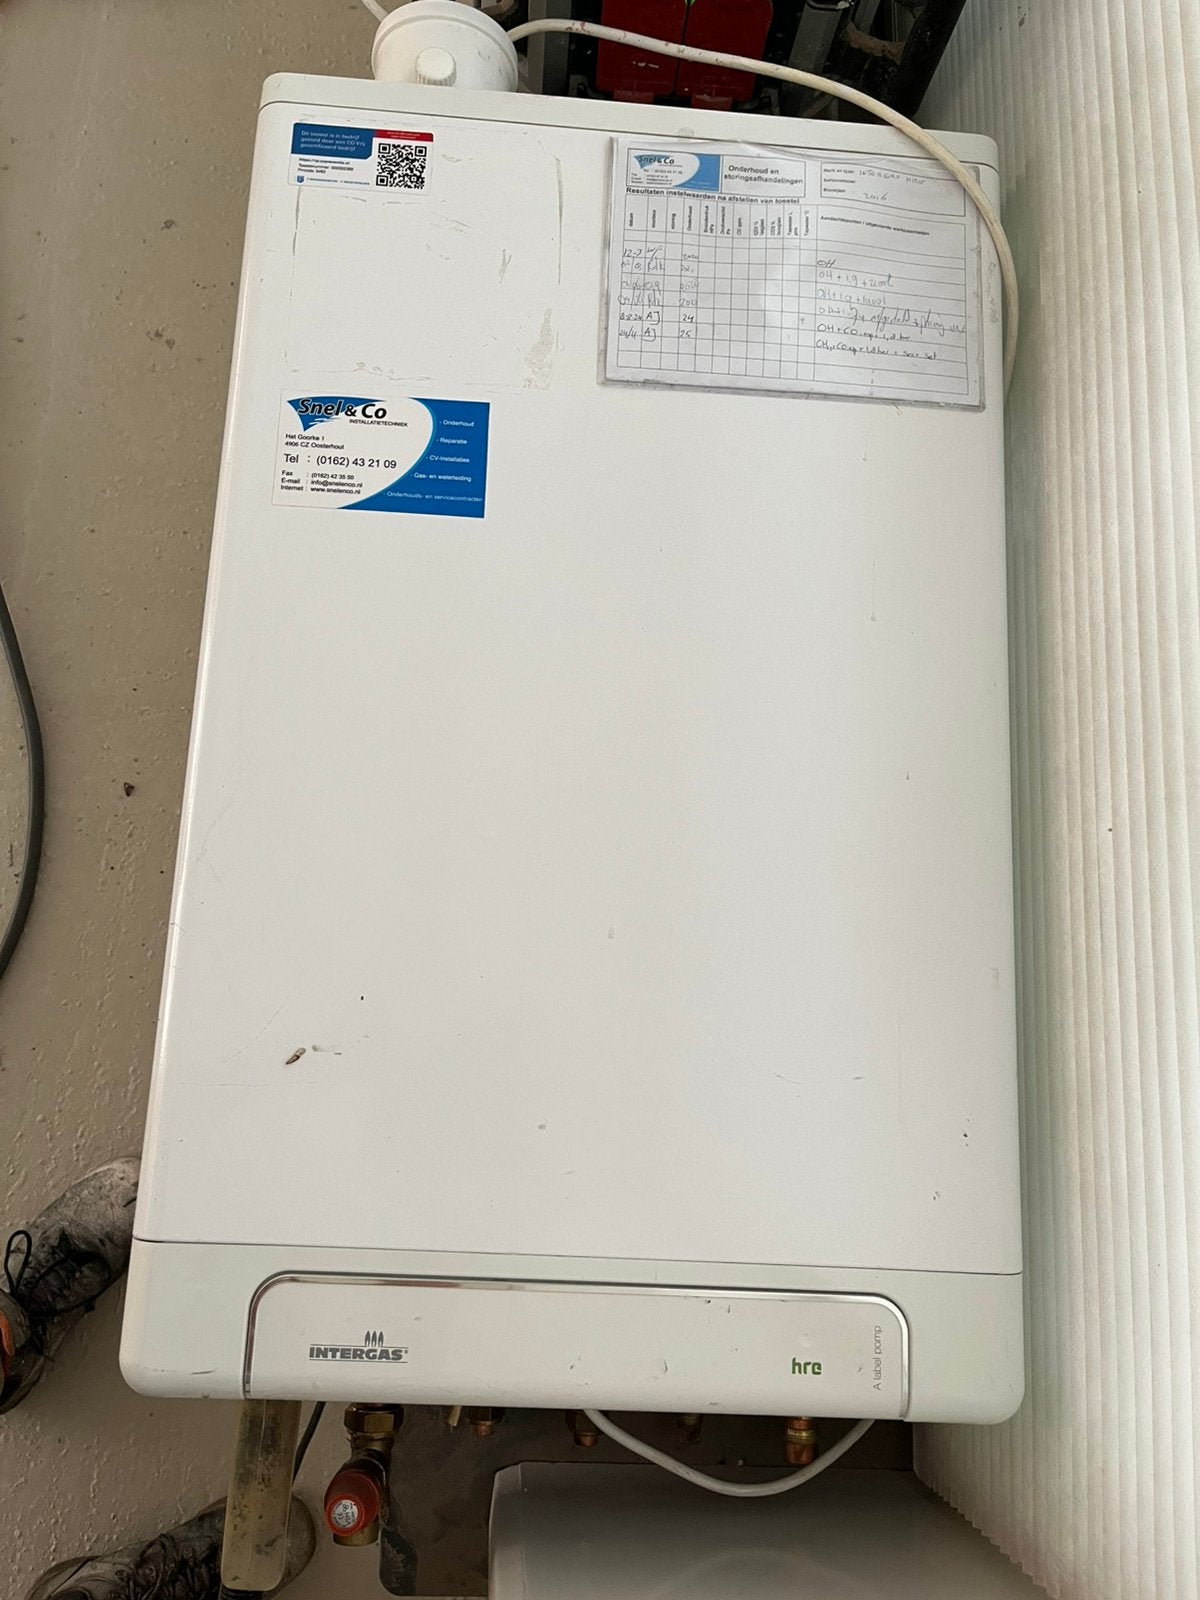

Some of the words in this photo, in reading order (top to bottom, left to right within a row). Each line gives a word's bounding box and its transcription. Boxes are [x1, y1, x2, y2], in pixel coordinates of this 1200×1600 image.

[728, 165, 768, 174] Onderhoud
[724, 174, 803, 185] storingsafhandelingen
[626, 187, 664, 195] Resultaten
[666, 189, 716, 200] instelwaarden
[682, 313, 695, 324] 24
[680, 329, 692, 338] 25
[298, 398, 343, 416] Snel
[361, 403, 387, 419] Co
[349, 419, 408, 427] INSTALLATIETECHNIEK
[443, 419, 475, 427] Onderhoud
[440, 437, 468, 445] Reparatie
[311, 442, 345, 450] Oosterhout
[284, 453, 299, 463] Tel
[316, 455, 350, 468] (0162)
[352, 458, 365, 467] 43
[368, 459, 380, 468] 21
[383, 459, 397, 469] 09
[429, 454, 470, 463] CV-installaties
[438, 474, 472, 483] waterleiding
[311, 479, 363, 488] info@snelenco.nl
[310, 487, 361, 495] www.snelenco.nl
[434, 494, 483, 502] servicecontracten
[873, 1325, 883, 1355] pomp
[309, 1347, 403, 1361] INTERGAS
[791, 1357, 822, 1375] hre
[872, 1357, 881, 1381] label
[872, 1382, 881, 1391] A
